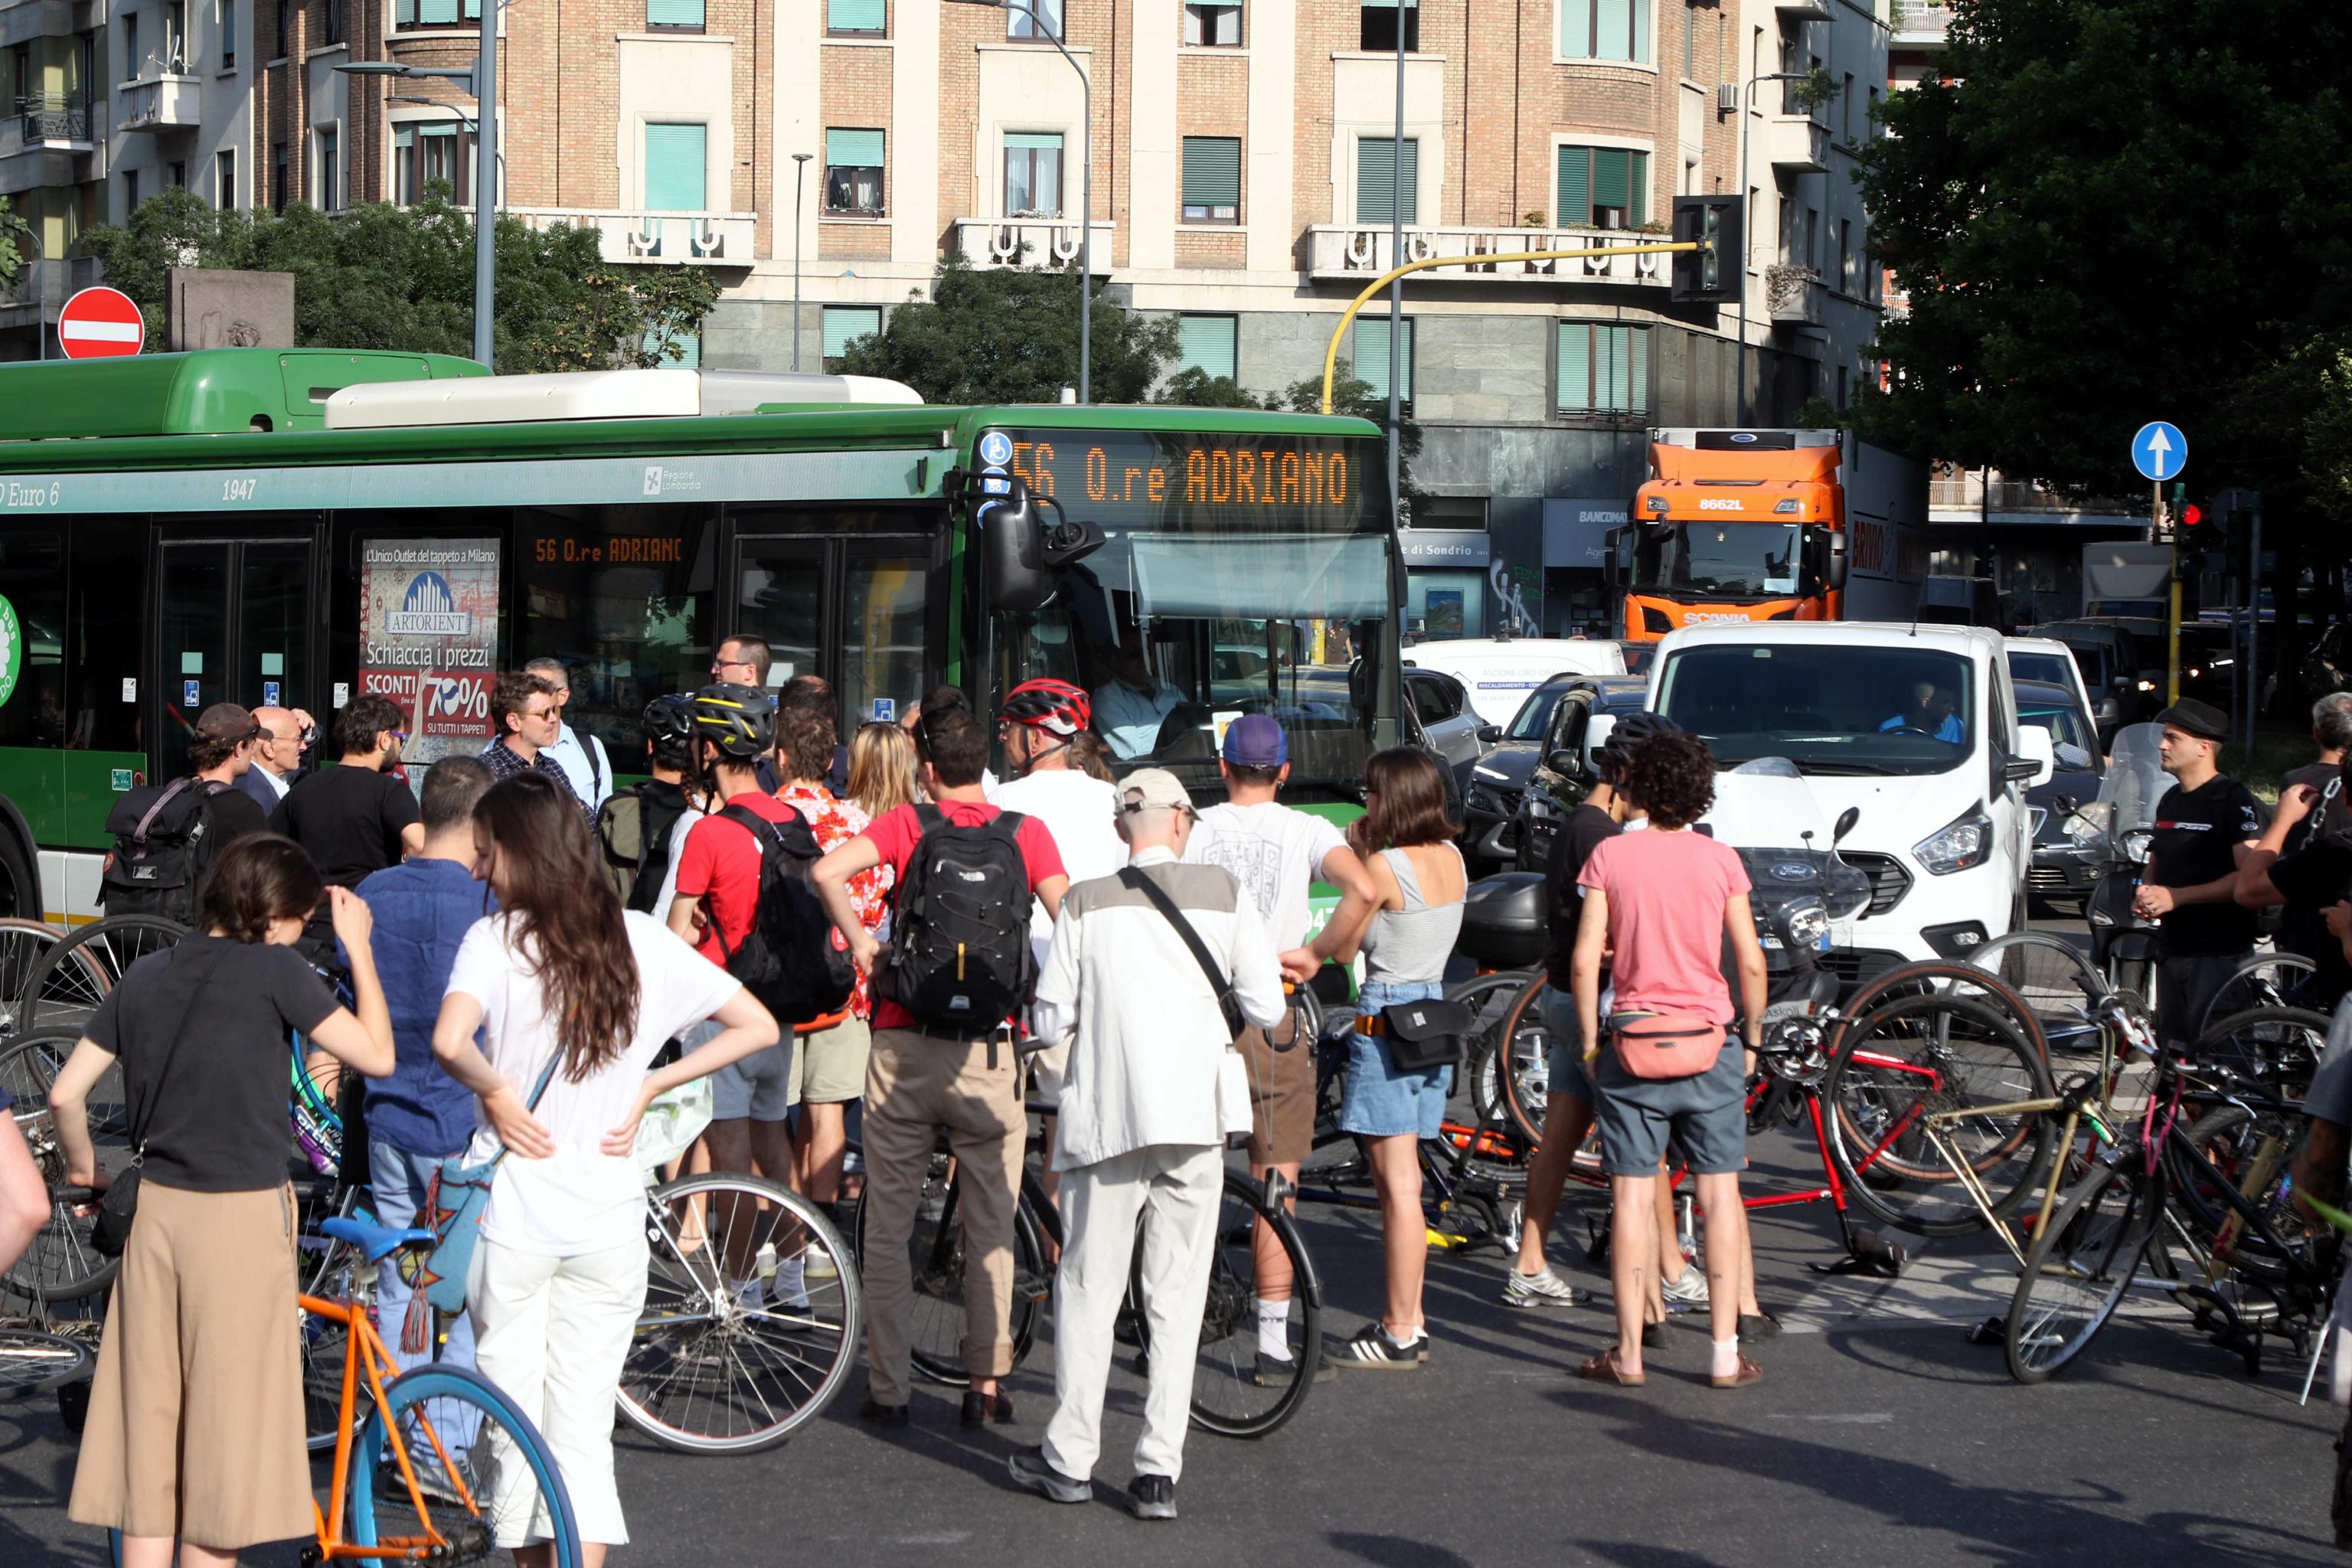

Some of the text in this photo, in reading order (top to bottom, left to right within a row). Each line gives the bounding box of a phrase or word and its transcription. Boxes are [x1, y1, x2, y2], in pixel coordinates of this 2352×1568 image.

[663, 470, 694, 482] Regione
[1013, 442, 1347, 507] 56 Q.re ADRIANO
[222, 479, 256, 501] 1947
[662, 481, 701, 490] Lombardia
[8, 482, 45, 507] Euro
[50, 482, 60, 506] 6
[1699, 498, 1744, 511] 8662L
[536, 538, 557, 562] 56
[564, 538, 602, 562] Q.re
[1411, 545, 1423, 555] di
[1426, 544, 1472, 555] Sondrio
[1853, 521, 1883, 572] BRIVIO
[367, 549, 495, 565] L'Unico Outlet del tappeto a Milano
[392, 615, 465, 632] ARTORIENT
[1684, 612, 1751, 624] SCANIA
[367, 640, 489, 671] Schiaccia i prezzi
[366, 674, 416, 694] SCONTI
[427, 722, 436, 733] SU
[437, 723, 456, 733] TUTTI
[461, 724, 486, 735] TAPPETI
[1779, 865, 1807, 876] Ford
[1766, 1005, 1800, 1018] Askoll
